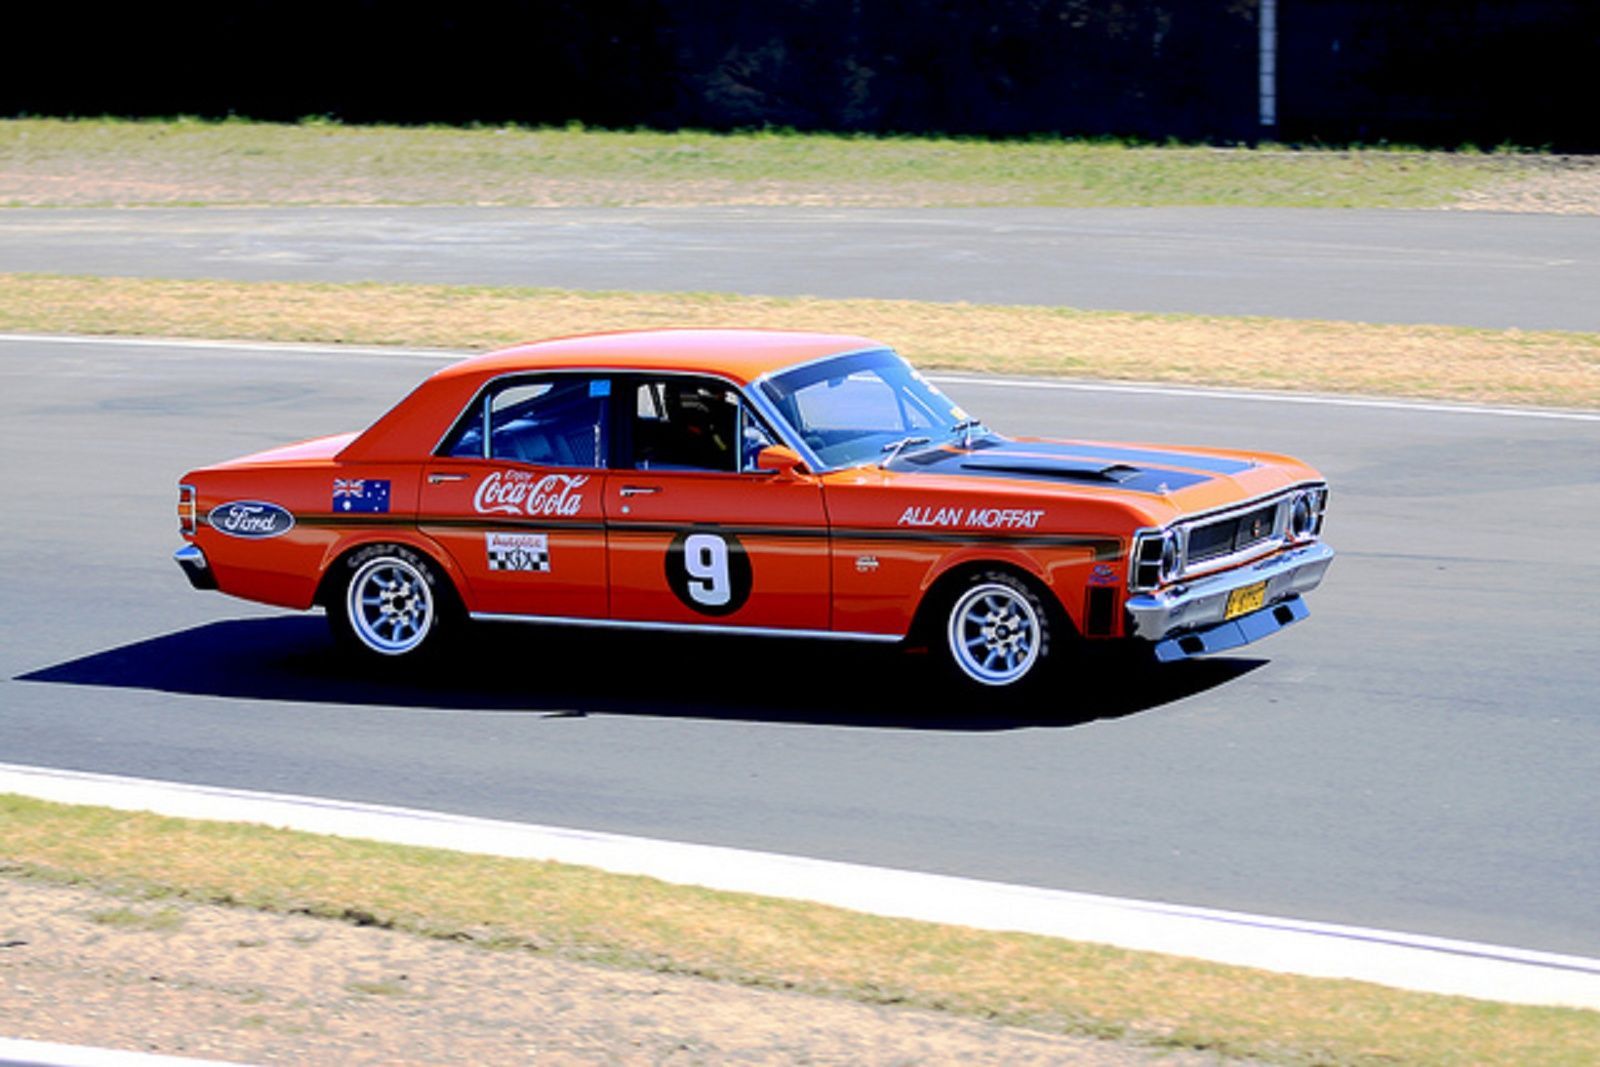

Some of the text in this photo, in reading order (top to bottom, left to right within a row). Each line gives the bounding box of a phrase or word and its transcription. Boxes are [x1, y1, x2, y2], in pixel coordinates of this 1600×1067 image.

[474, 471, 590, 515] Coca-Cola
[224, 506, 276, 531] Ford
[897, 506, 1045, 528] ALLAN MOFFAT
[684, 534, 731, 606] 9
